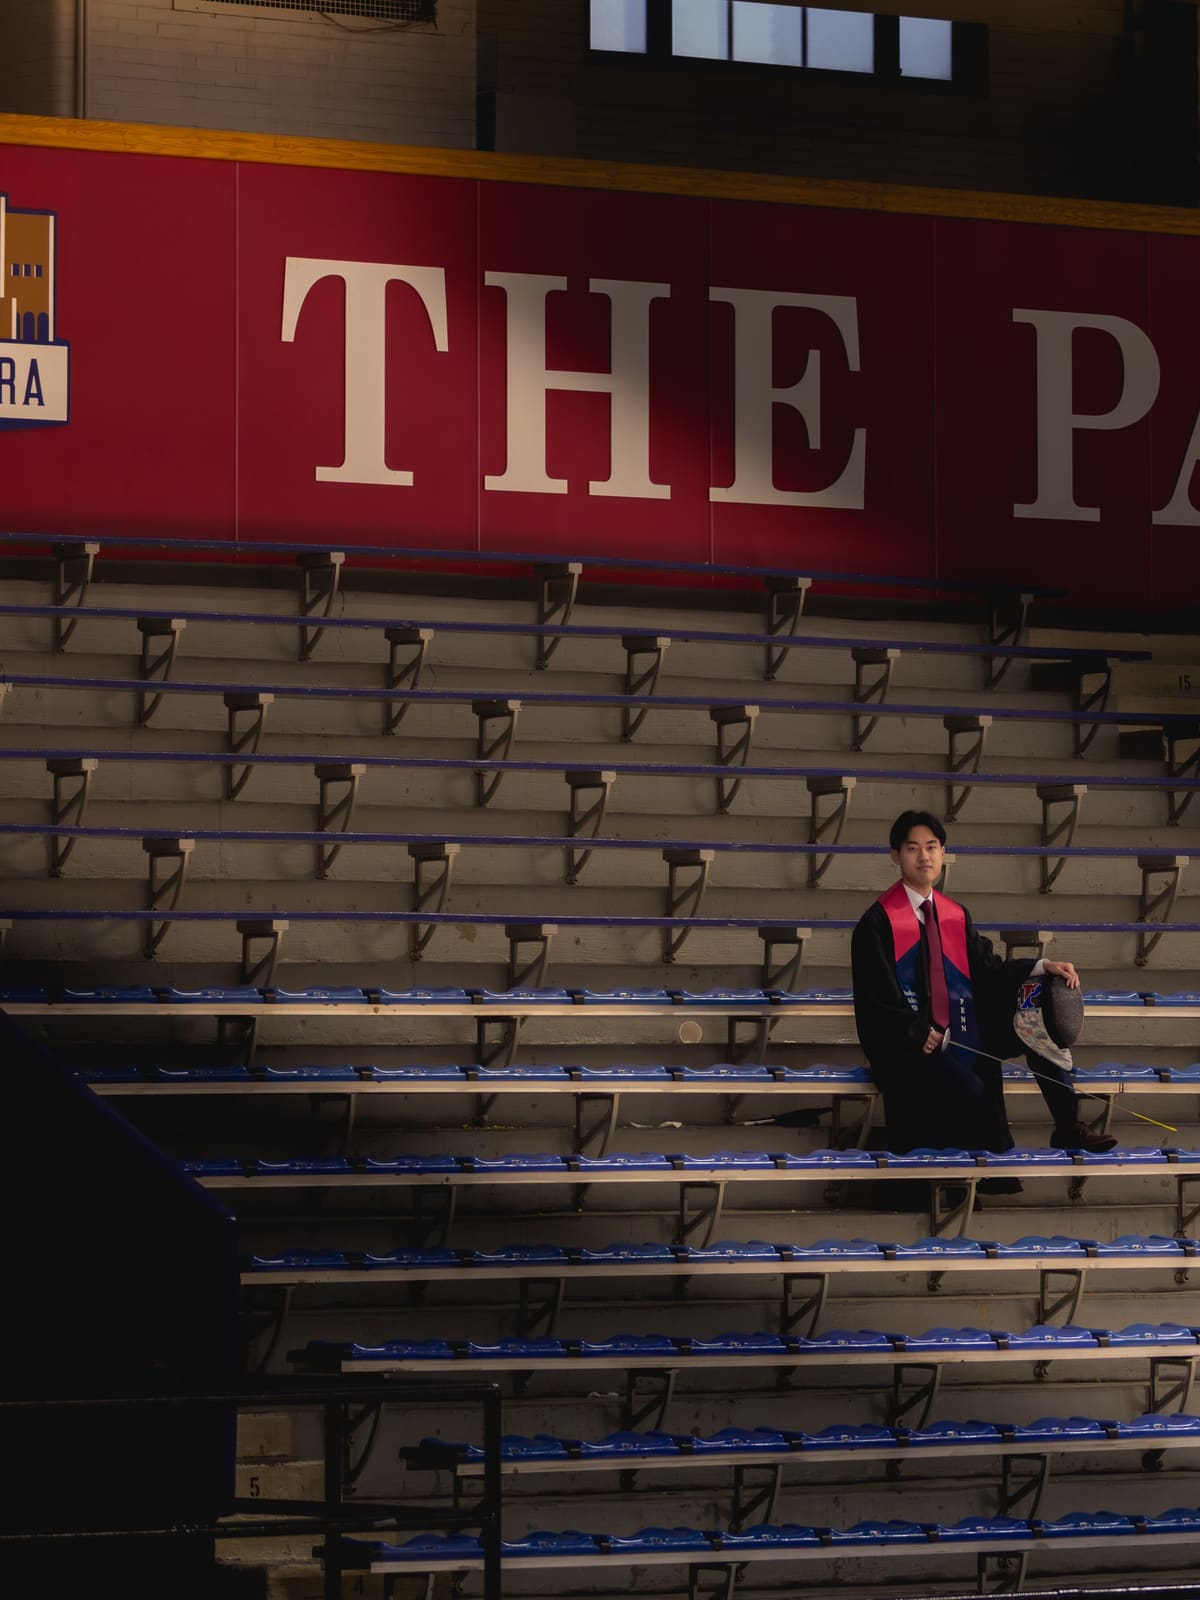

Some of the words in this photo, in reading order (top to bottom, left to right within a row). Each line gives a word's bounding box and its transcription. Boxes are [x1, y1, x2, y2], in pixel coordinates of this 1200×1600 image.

[281, 256, 866, 510] THE
[1178, 673, 1192, 690] 15
[249, 1476, 260, 1497] 5
